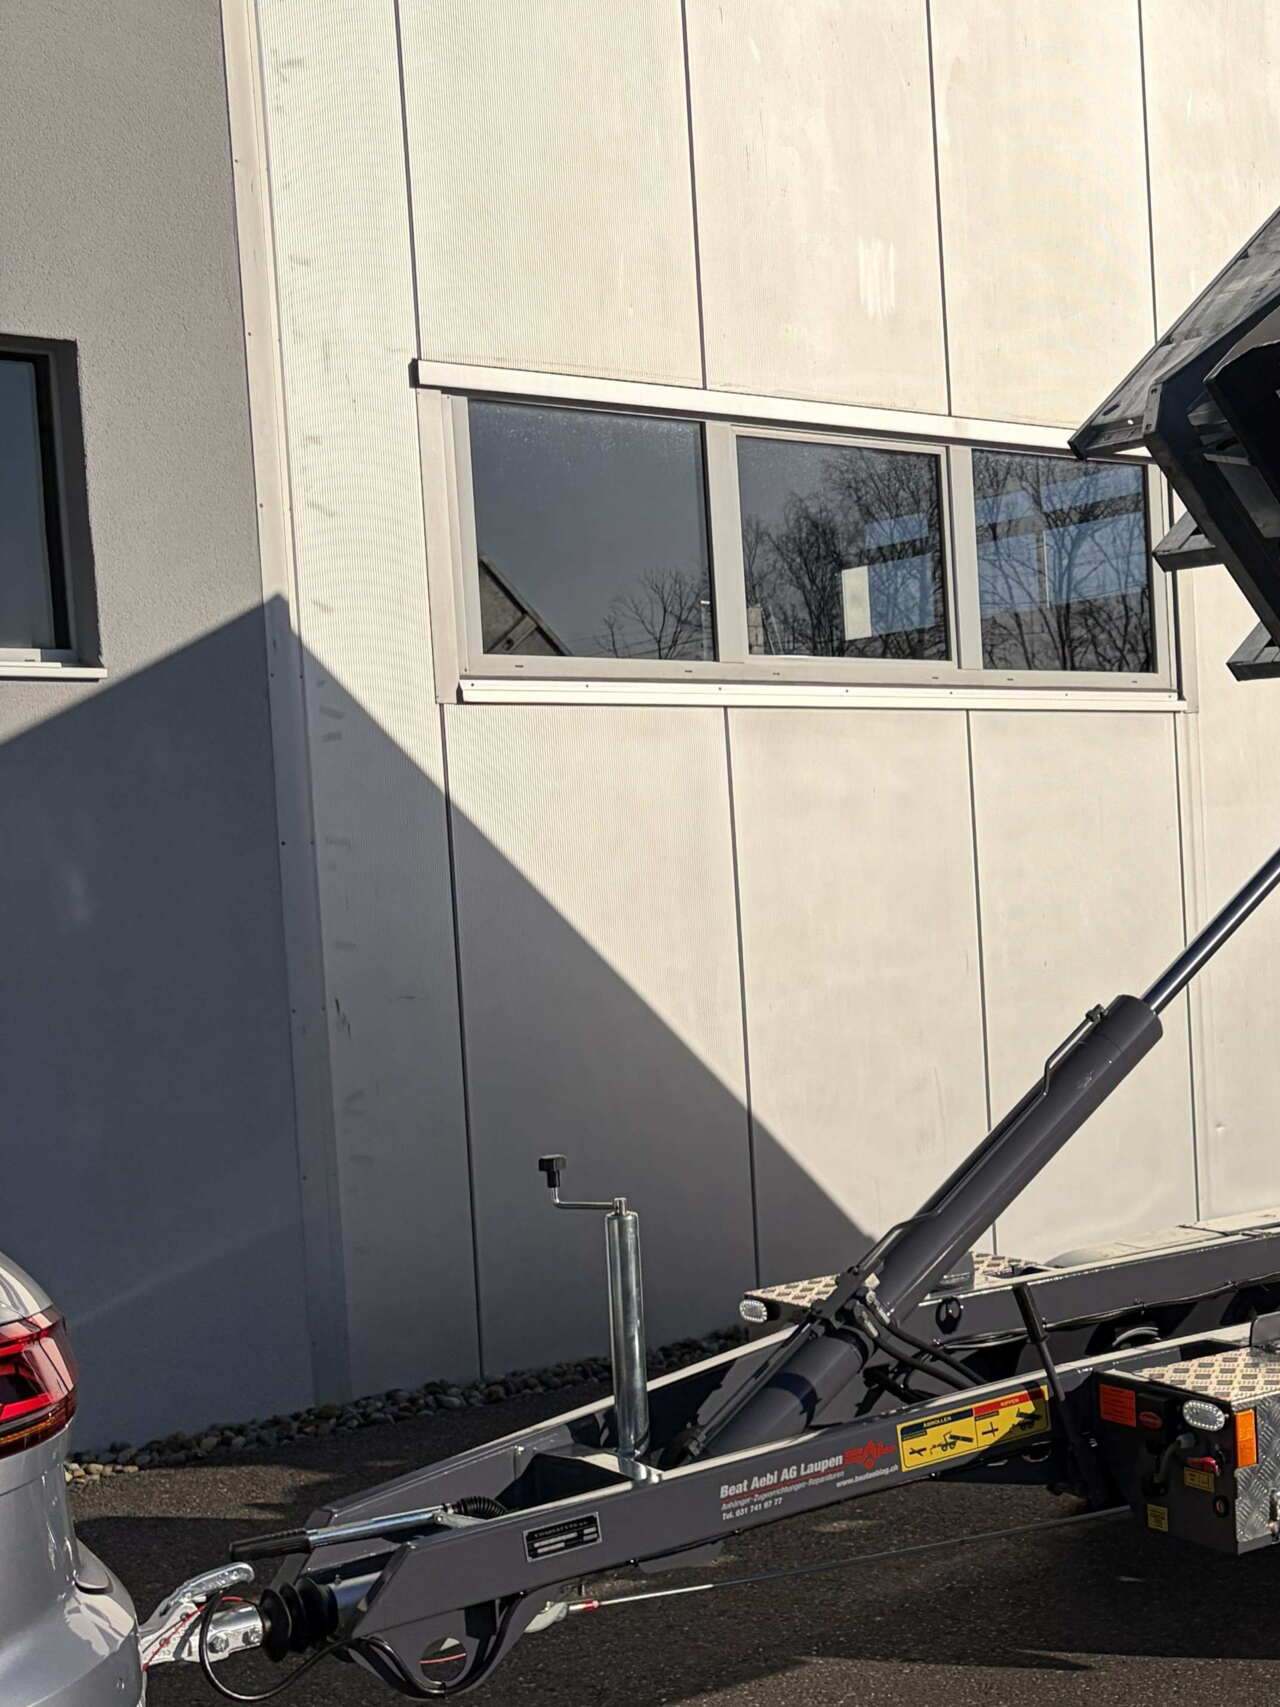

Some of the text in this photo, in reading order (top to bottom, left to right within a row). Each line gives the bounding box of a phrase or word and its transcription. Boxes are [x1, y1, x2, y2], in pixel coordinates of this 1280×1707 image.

[720, 1481, 748, 1498] Beat
[780, 1466, 797, 1482] AG
[800, 1455, 843, 1476] Laupen
